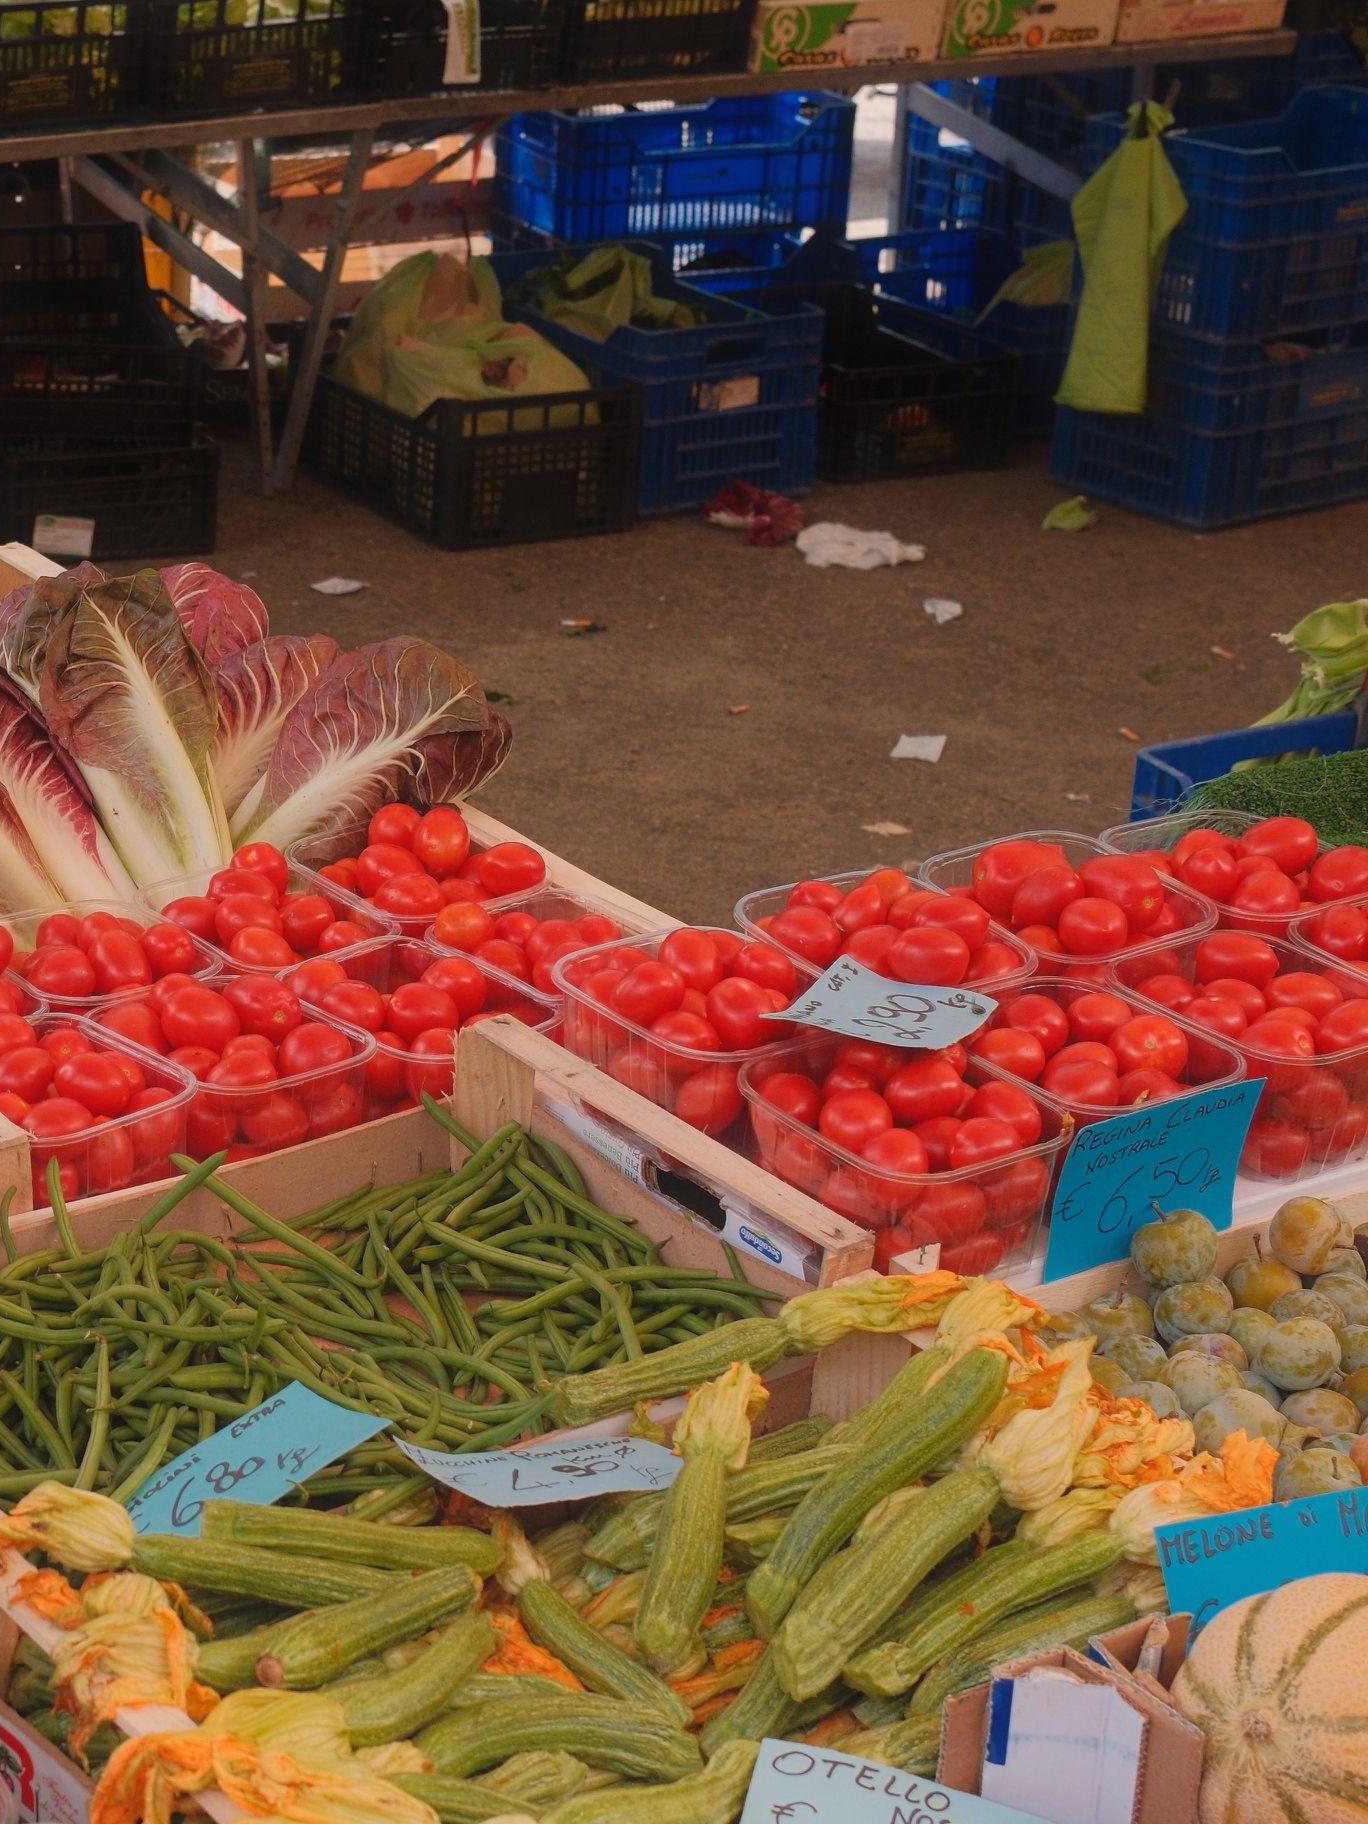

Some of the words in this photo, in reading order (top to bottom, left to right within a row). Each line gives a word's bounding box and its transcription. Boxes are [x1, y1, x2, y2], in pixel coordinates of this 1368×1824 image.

[1072, 1116, 1151, 1158] REGINA
[1166, 1088, 1245, 1130] CLAUDIA
[1086, 1131, 1169, 1176] NOSTRALE
[1055, 1181, 1092, 1222] €
[1097, 1147, 1210, 1234] 6,50
[230, 1398, 287, 1440] EXTRA
[1159, 1511, 1274, 1569] MELONE
[771, 1750, 951, 1812] OTELLO
